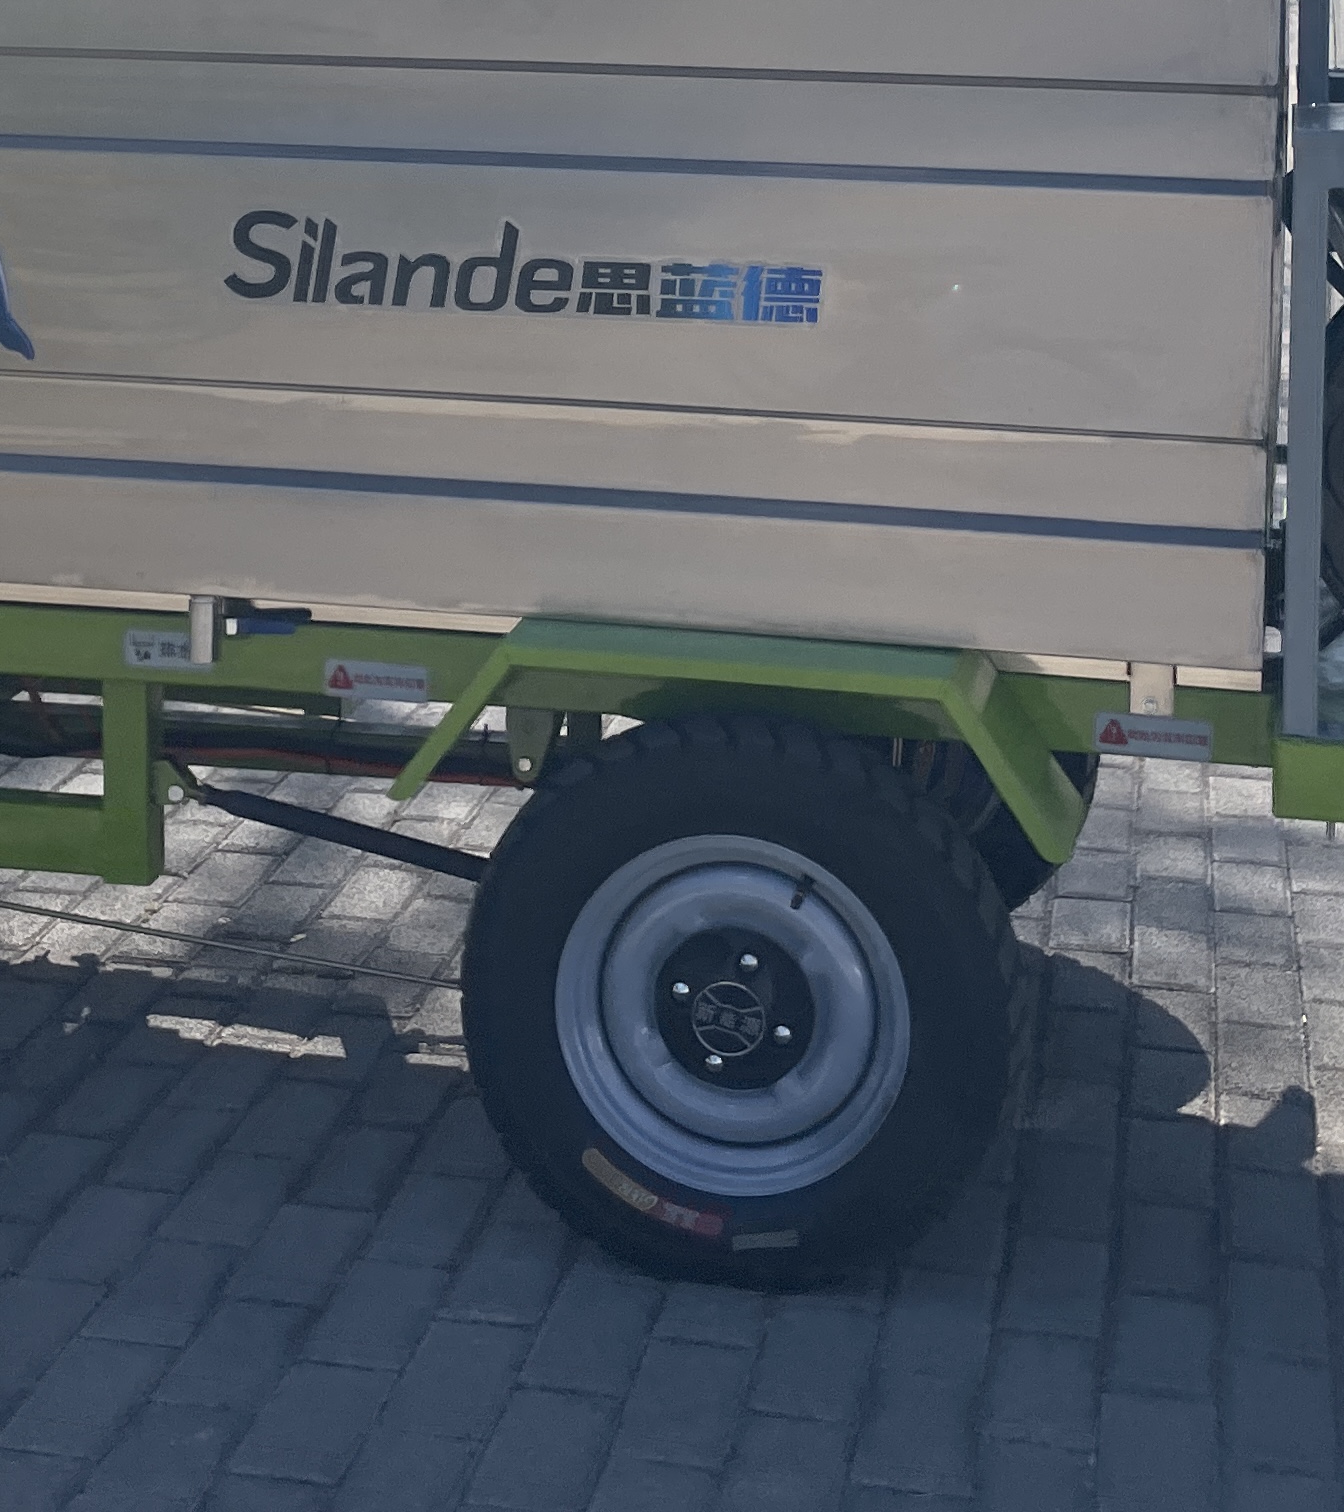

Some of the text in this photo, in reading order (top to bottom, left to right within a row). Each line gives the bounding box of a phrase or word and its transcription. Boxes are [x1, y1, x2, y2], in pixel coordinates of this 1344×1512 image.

[223, 209, 824, 324] Silande 思蓝德
